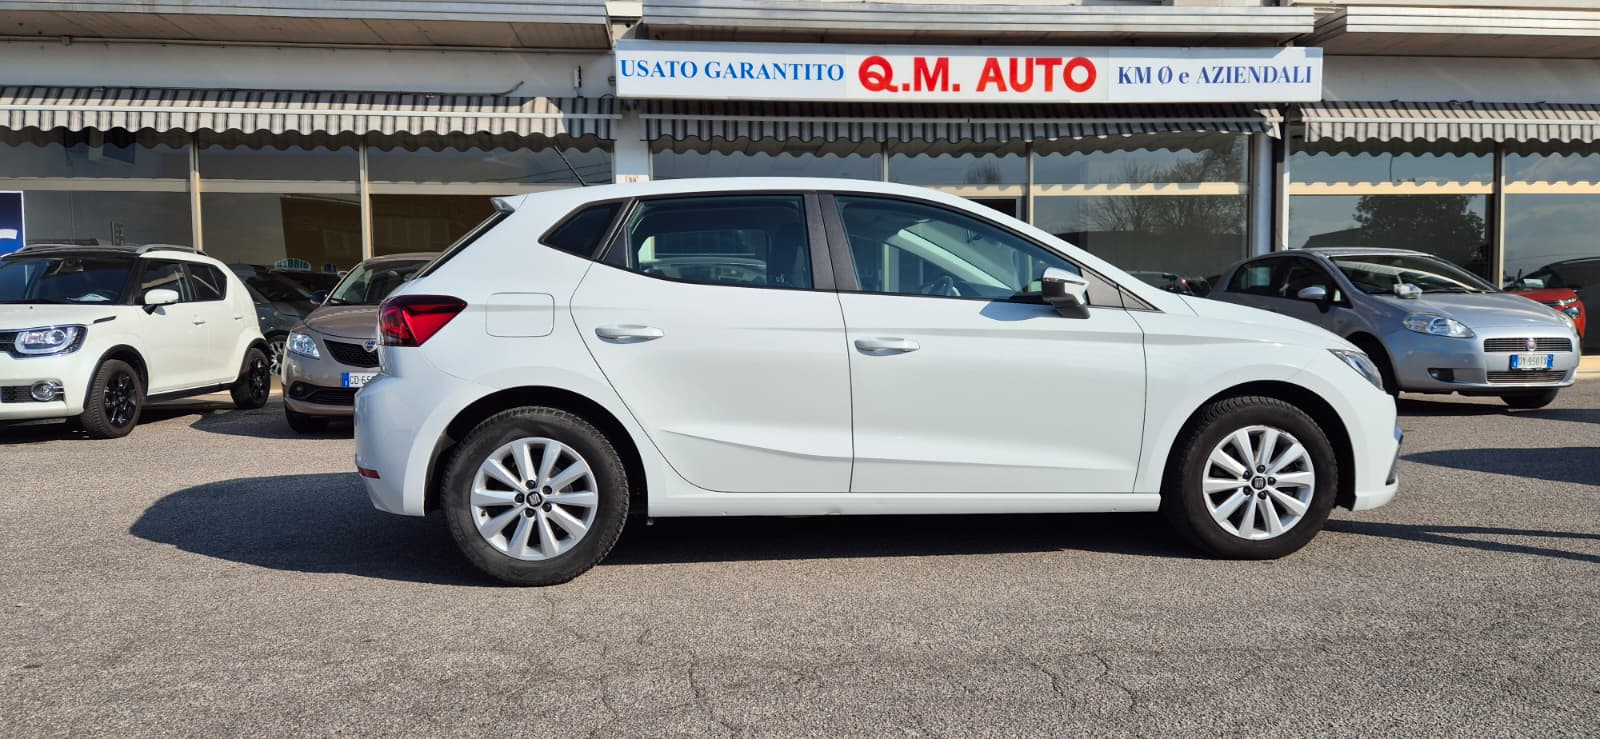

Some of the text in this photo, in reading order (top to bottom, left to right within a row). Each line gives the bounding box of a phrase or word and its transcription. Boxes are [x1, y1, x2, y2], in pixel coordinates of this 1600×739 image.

[620, 59, 845, 81] USATO GARANTITO
[858, 55, 1097, 93] Q.M. AUTO
[1118, 66, 1151, 84] KM
[1178, 71, 1190, 84] e
[1197, 66, 1312, 84] AZIENDALI
